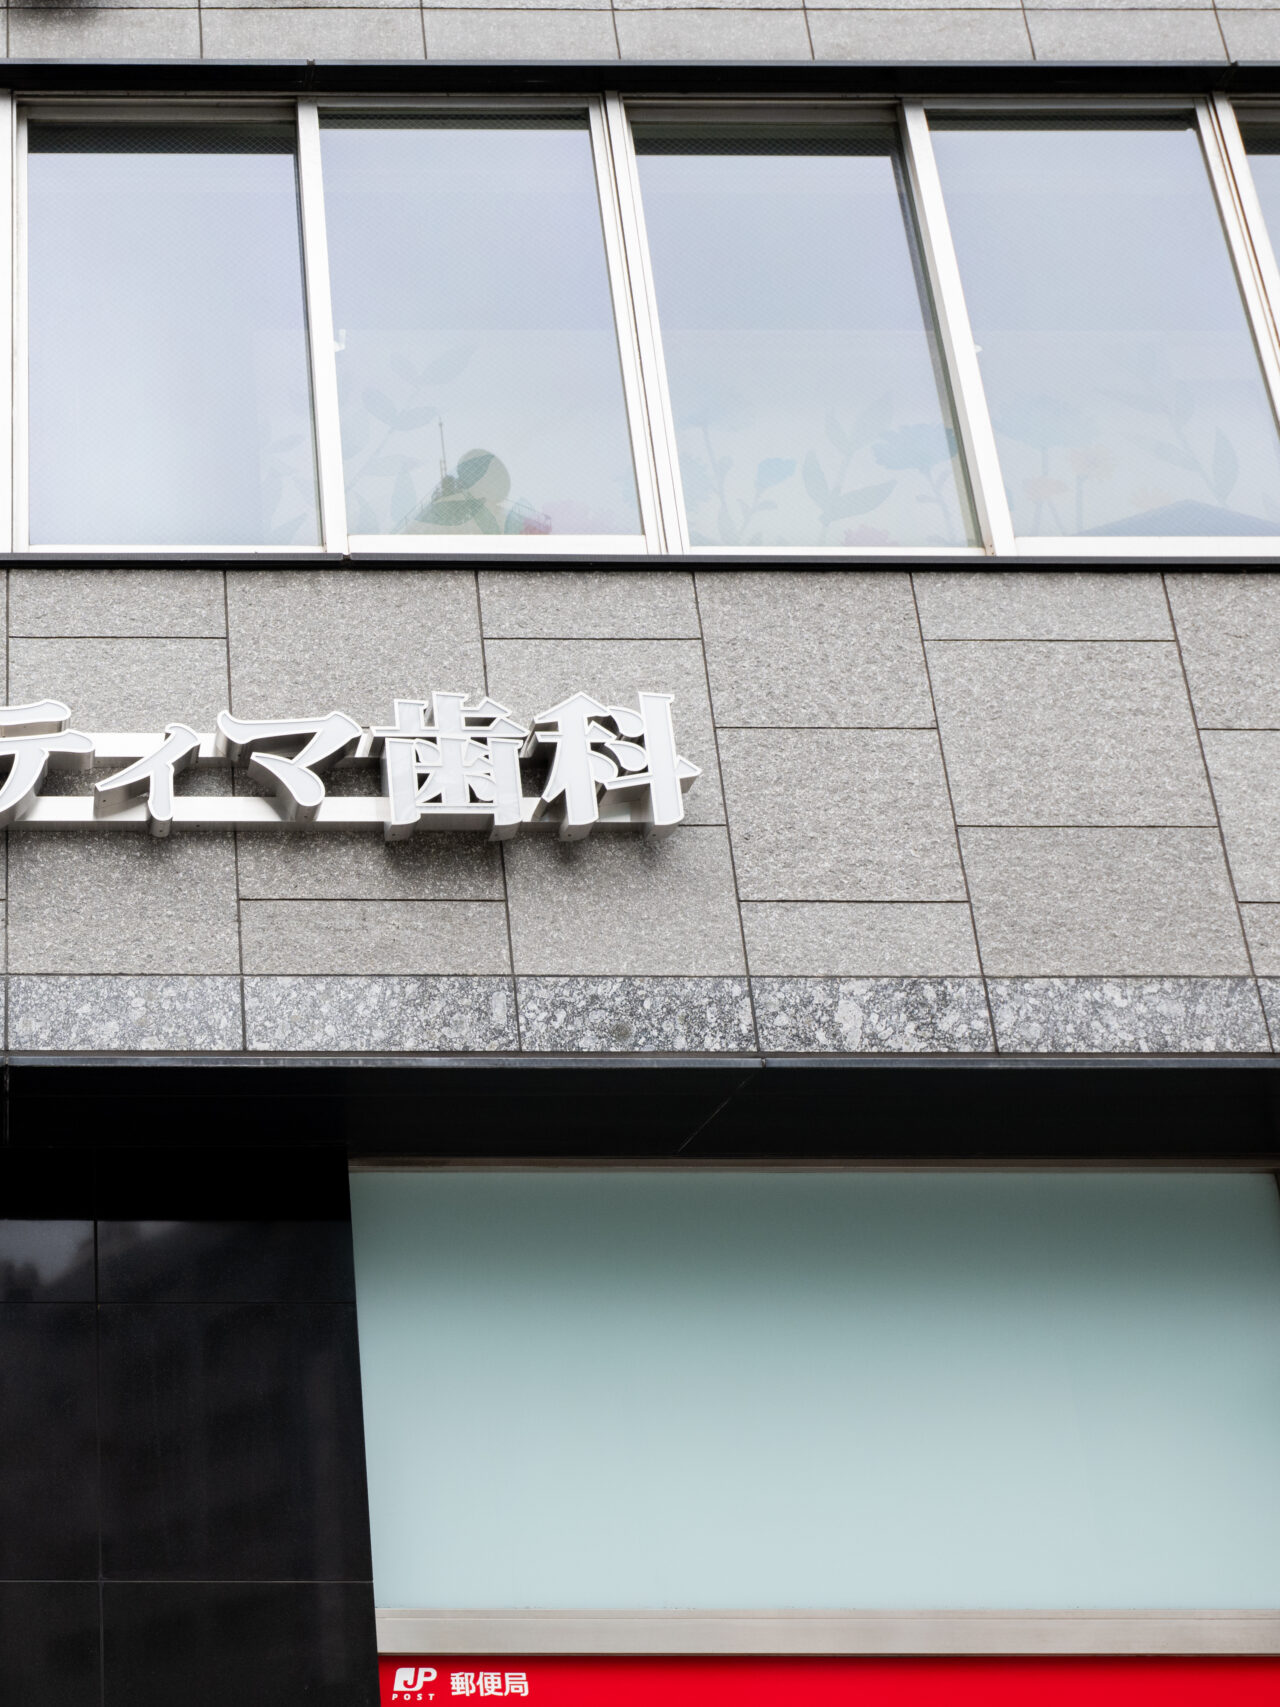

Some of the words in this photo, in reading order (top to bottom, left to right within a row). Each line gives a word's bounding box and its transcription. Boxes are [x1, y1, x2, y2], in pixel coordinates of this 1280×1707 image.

[393, 1667, 437, 1691] JP
[450, 1671, 529, 1696] 郵便局
